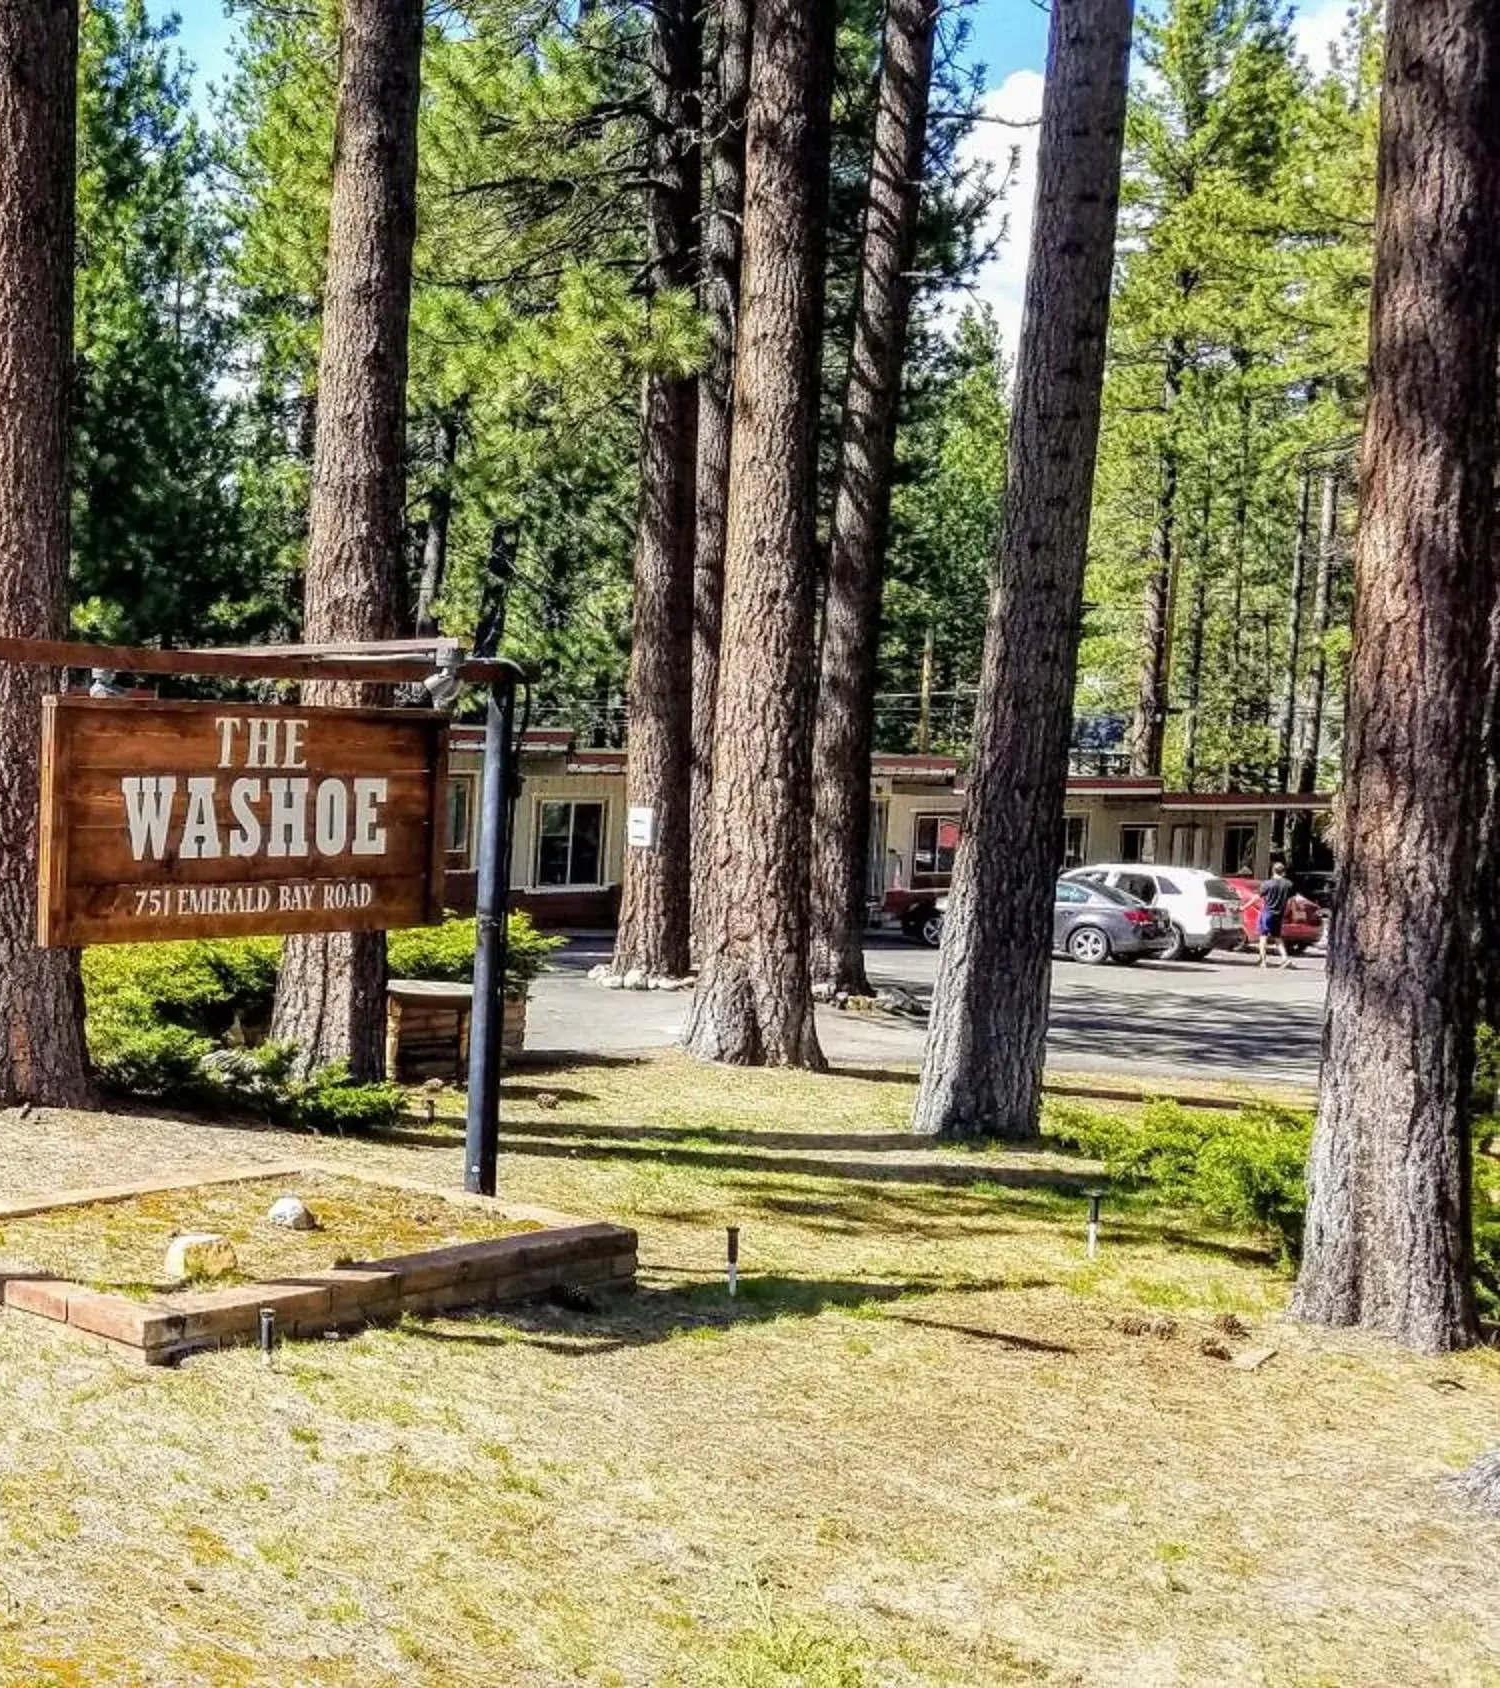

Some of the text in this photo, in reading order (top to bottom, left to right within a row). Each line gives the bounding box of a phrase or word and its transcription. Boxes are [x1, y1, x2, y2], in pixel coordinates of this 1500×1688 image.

[215, 717, 309, 769] THE
[121, 776, 388, 861] WASHOE
[135, 882, 373, 917] 751 EMERALD BAY ROAD
